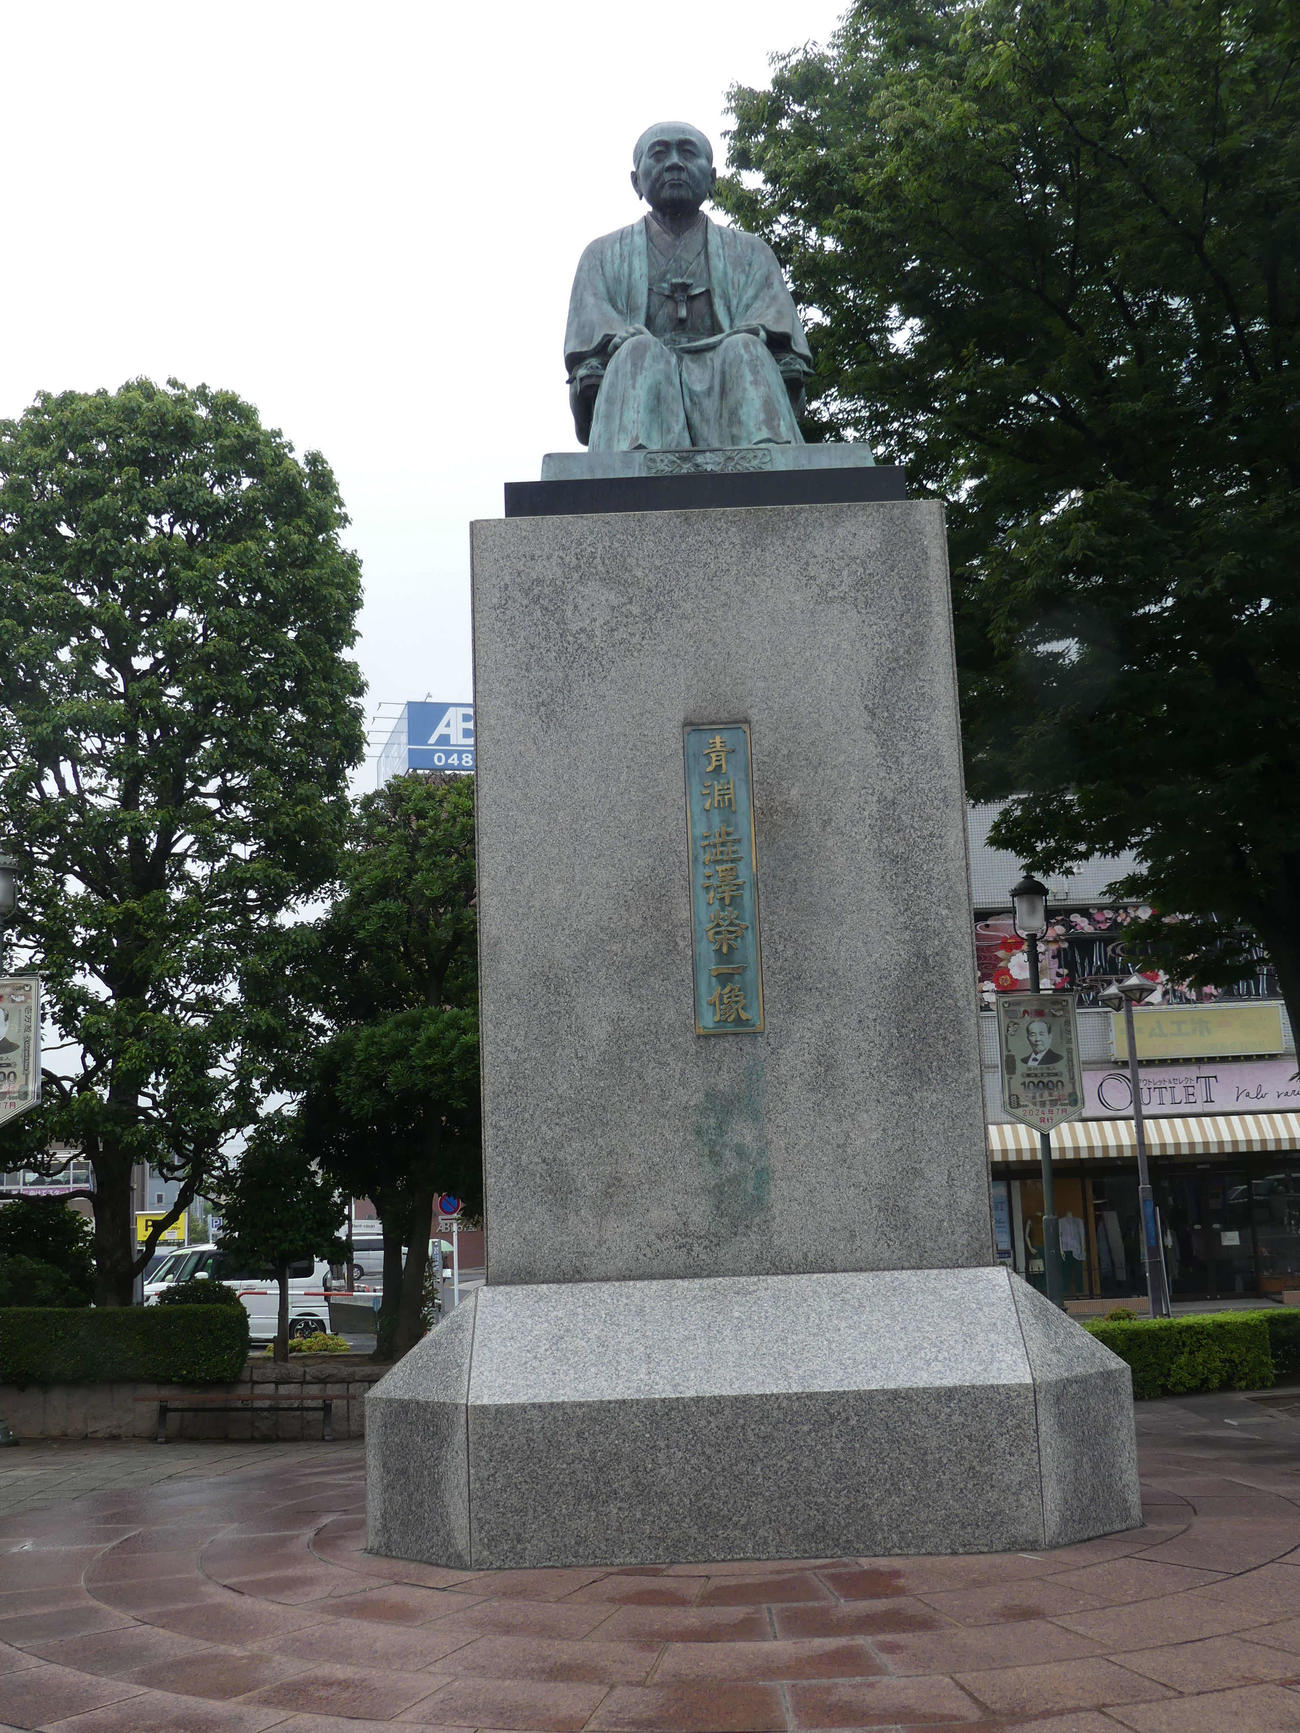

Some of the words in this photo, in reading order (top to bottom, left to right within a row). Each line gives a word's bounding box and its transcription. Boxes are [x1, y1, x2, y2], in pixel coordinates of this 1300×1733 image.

[434, 752, 473, 767] 048
[1020, 1080, 1065, 1092] 10000
[1097, 1073, 1218, 1111] OUTLET
